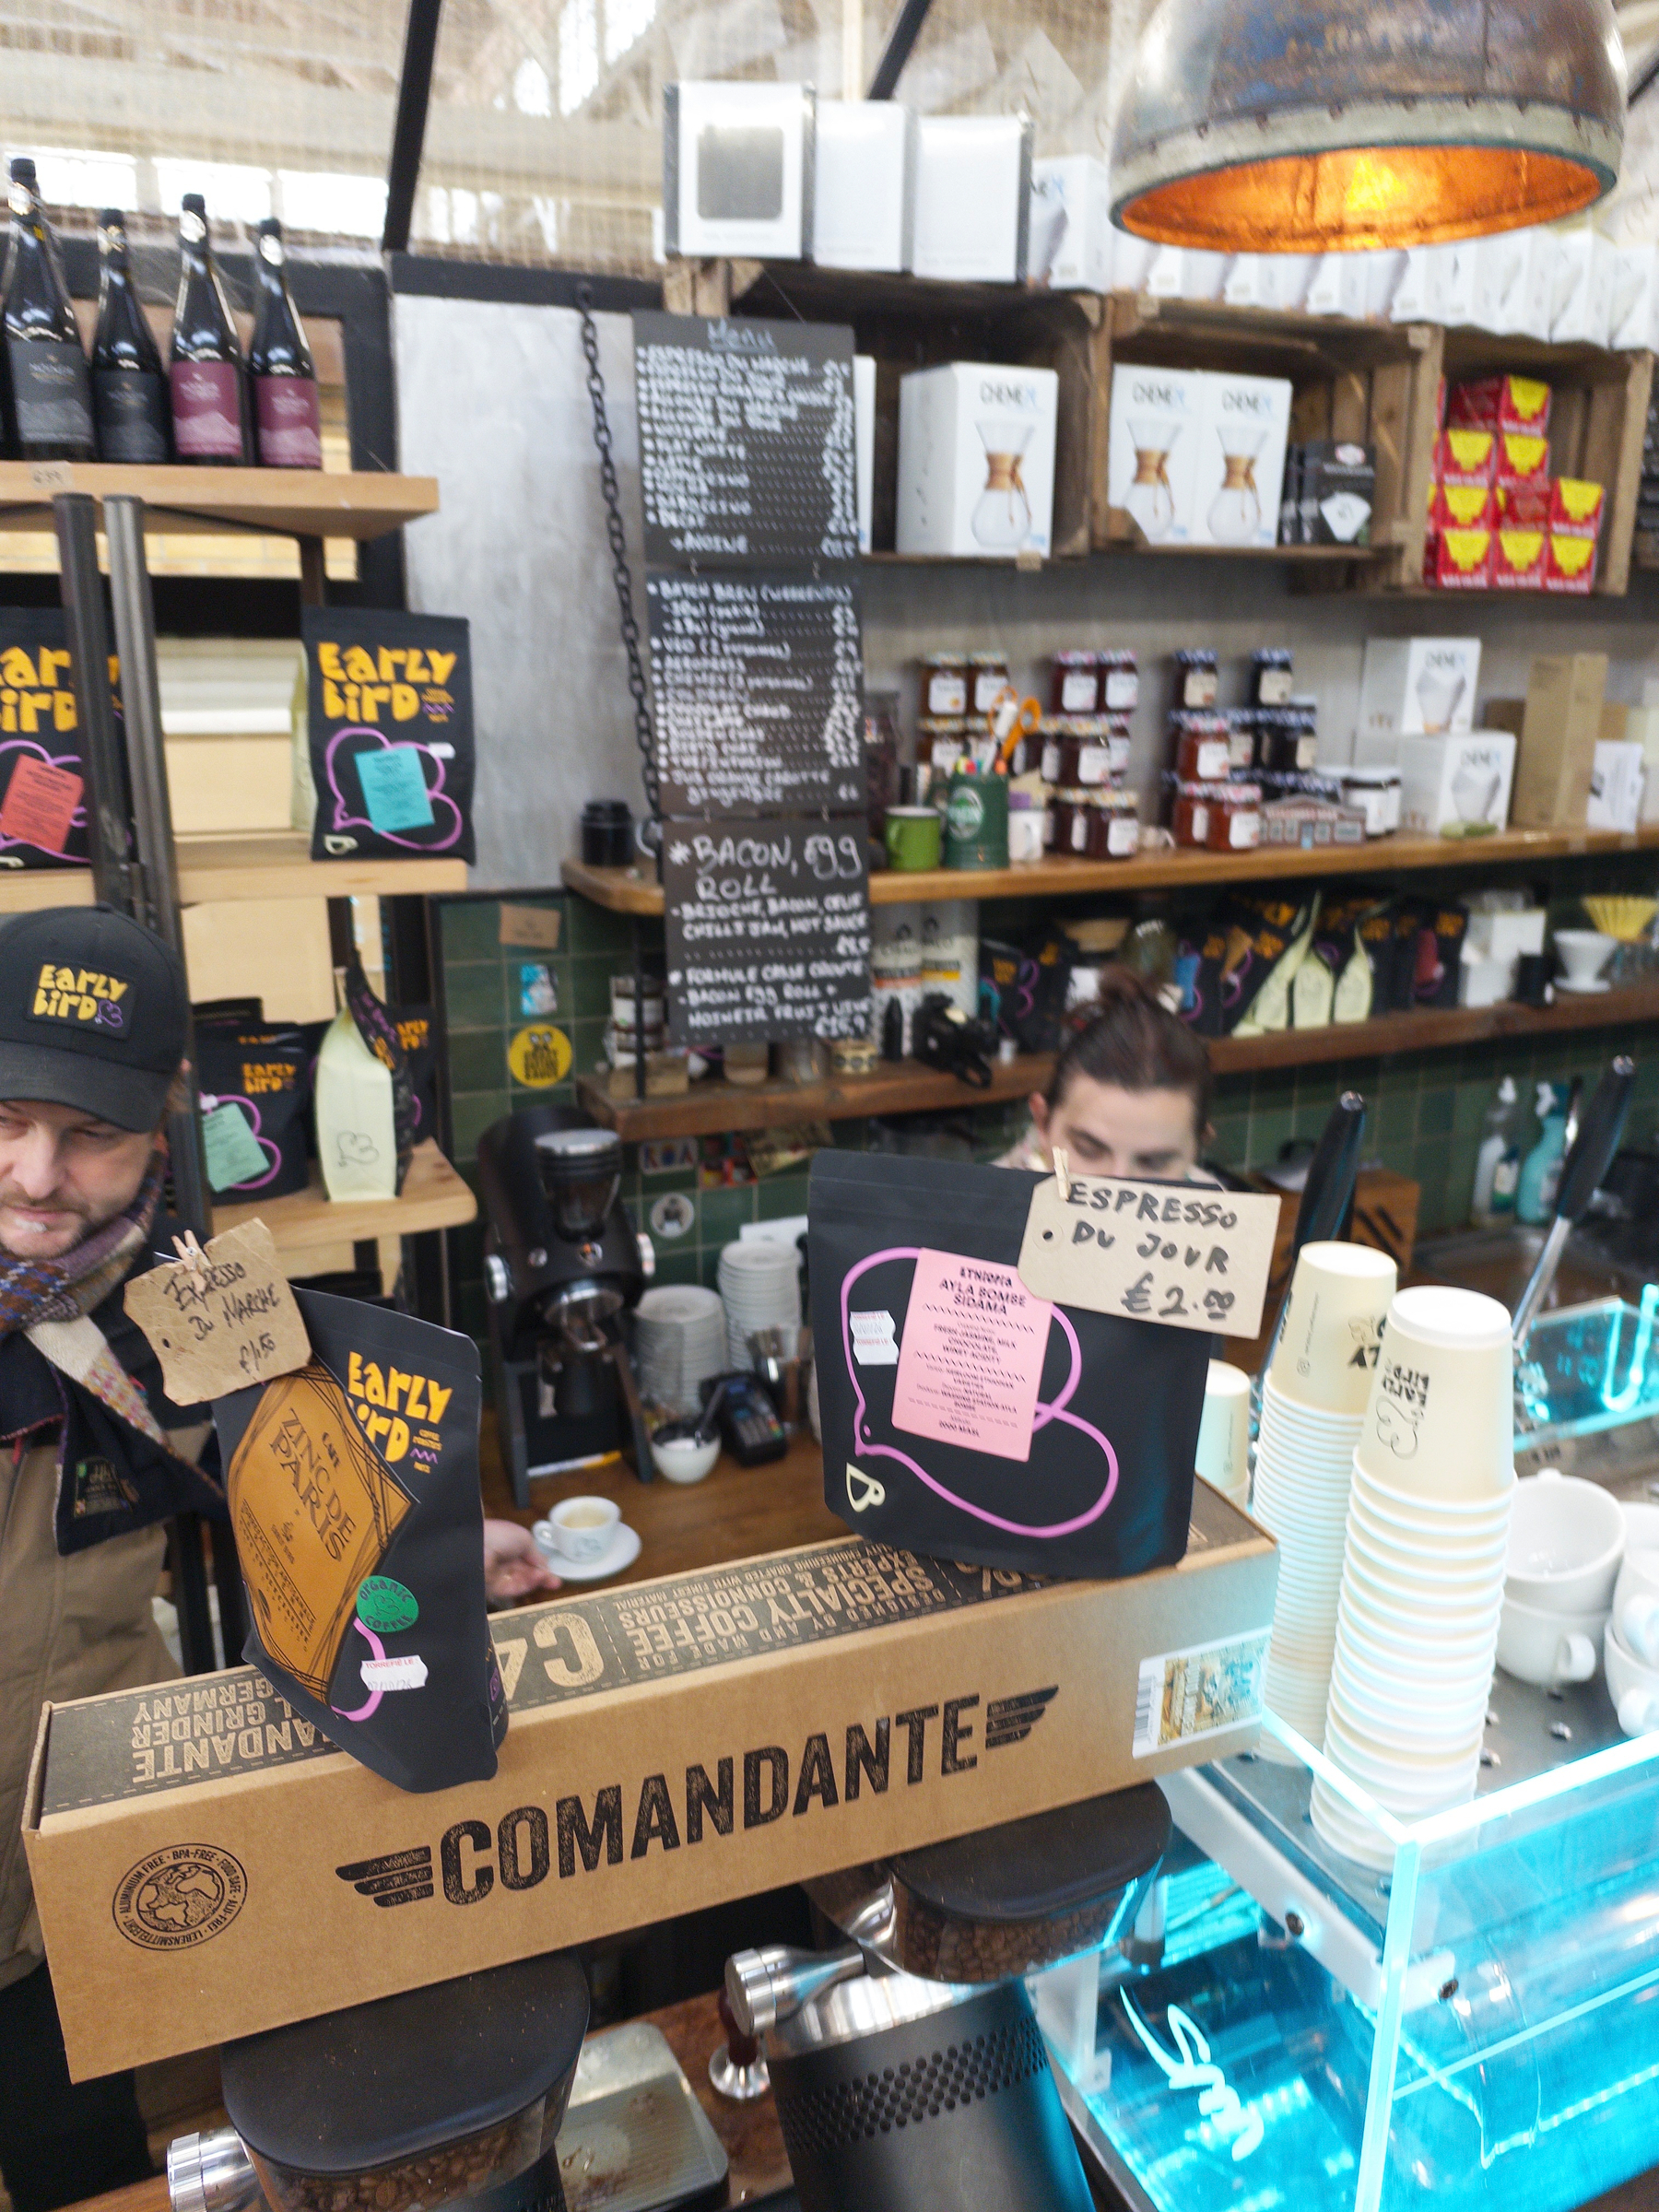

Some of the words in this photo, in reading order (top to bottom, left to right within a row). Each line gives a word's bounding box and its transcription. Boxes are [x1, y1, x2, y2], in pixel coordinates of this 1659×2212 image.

[695, 872, 778, 901] ROLL
[1066, 1182, 1238, 1230] ESPRESSO
[1072, 1221, 1116, 1248] DU
[1136, 1232, 1230, 1275] JOUR
[953, 1293, 1008, 1316] SIDAMA
[281, 1407, 331, 1495] ZINC
[326, 1488, 357, 1543] DE
[268, 1426, 346, 1562] PARIS
[712, 1574, 743, 1590] WITH
[766, 1566, 934, 1627] SPECIALTY
[794, 1571, 815, 1590] &
[613, 1590, 668, 1612] MATERIAL
[618, 1576, 792, 1630] CONNOISSEURS
[625, 1603, 759, 1657] COFFEE
[759, 1619, 800, 1643] AND
[812, 1613, 837, 1631] BY
[637, 1650, 679, 1671] FOR
[689, 1634, 749, 1660] MADE
[133, 1677, 276, 1724] GERMANY
[131, 1700, 266, 1749] GRINDER
[132, 1718, 318, 1784] ANDANTE
[441, 1694, 980, 1905] COMANDANTE
[141, 1854, 167, 1874] FREE
[171, 1848, 218, 1862] BPA-FREE
[218, 1858, 238, 1877] FOOD
[229, 1876, 241, 1895] SAFE
[207, 1899, 238, 1932] ALU-FREI
